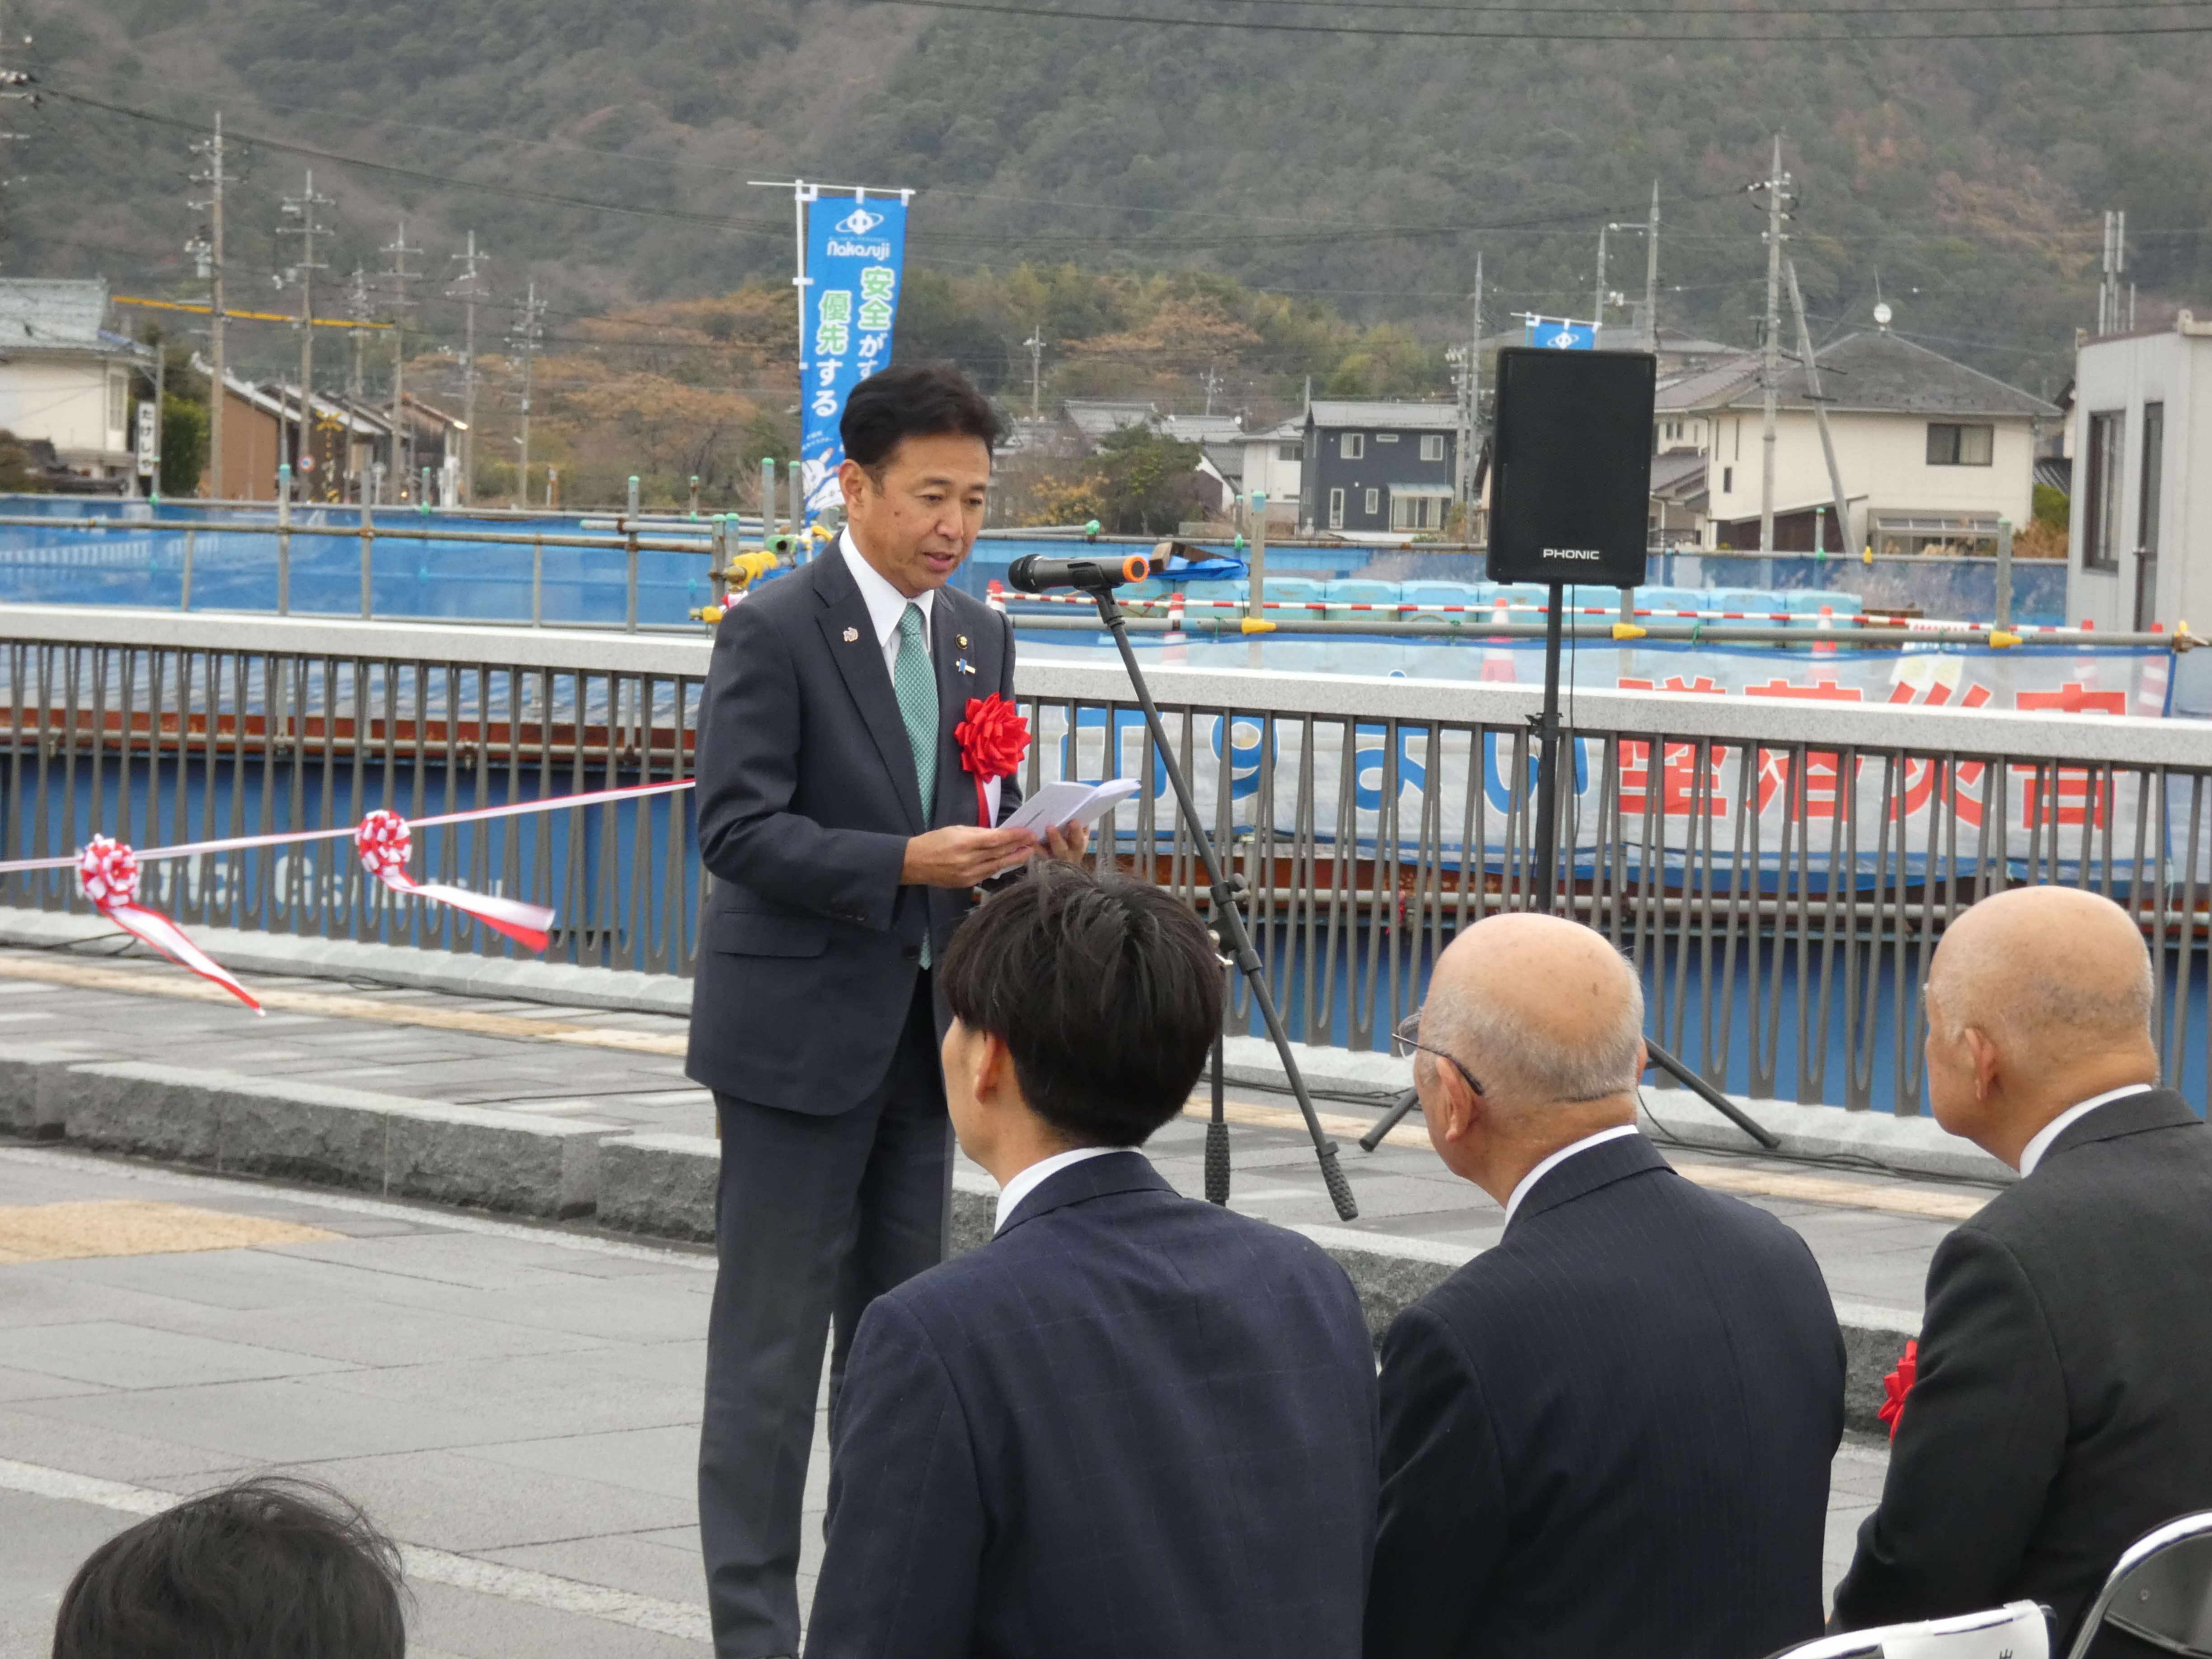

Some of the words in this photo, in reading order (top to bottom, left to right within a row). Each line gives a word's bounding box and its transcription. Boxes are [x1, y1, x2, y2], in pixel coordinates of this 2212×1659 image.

[812, 290, 851, 417] 優先する
[1543, 548, 1599, 560] PHONIC
